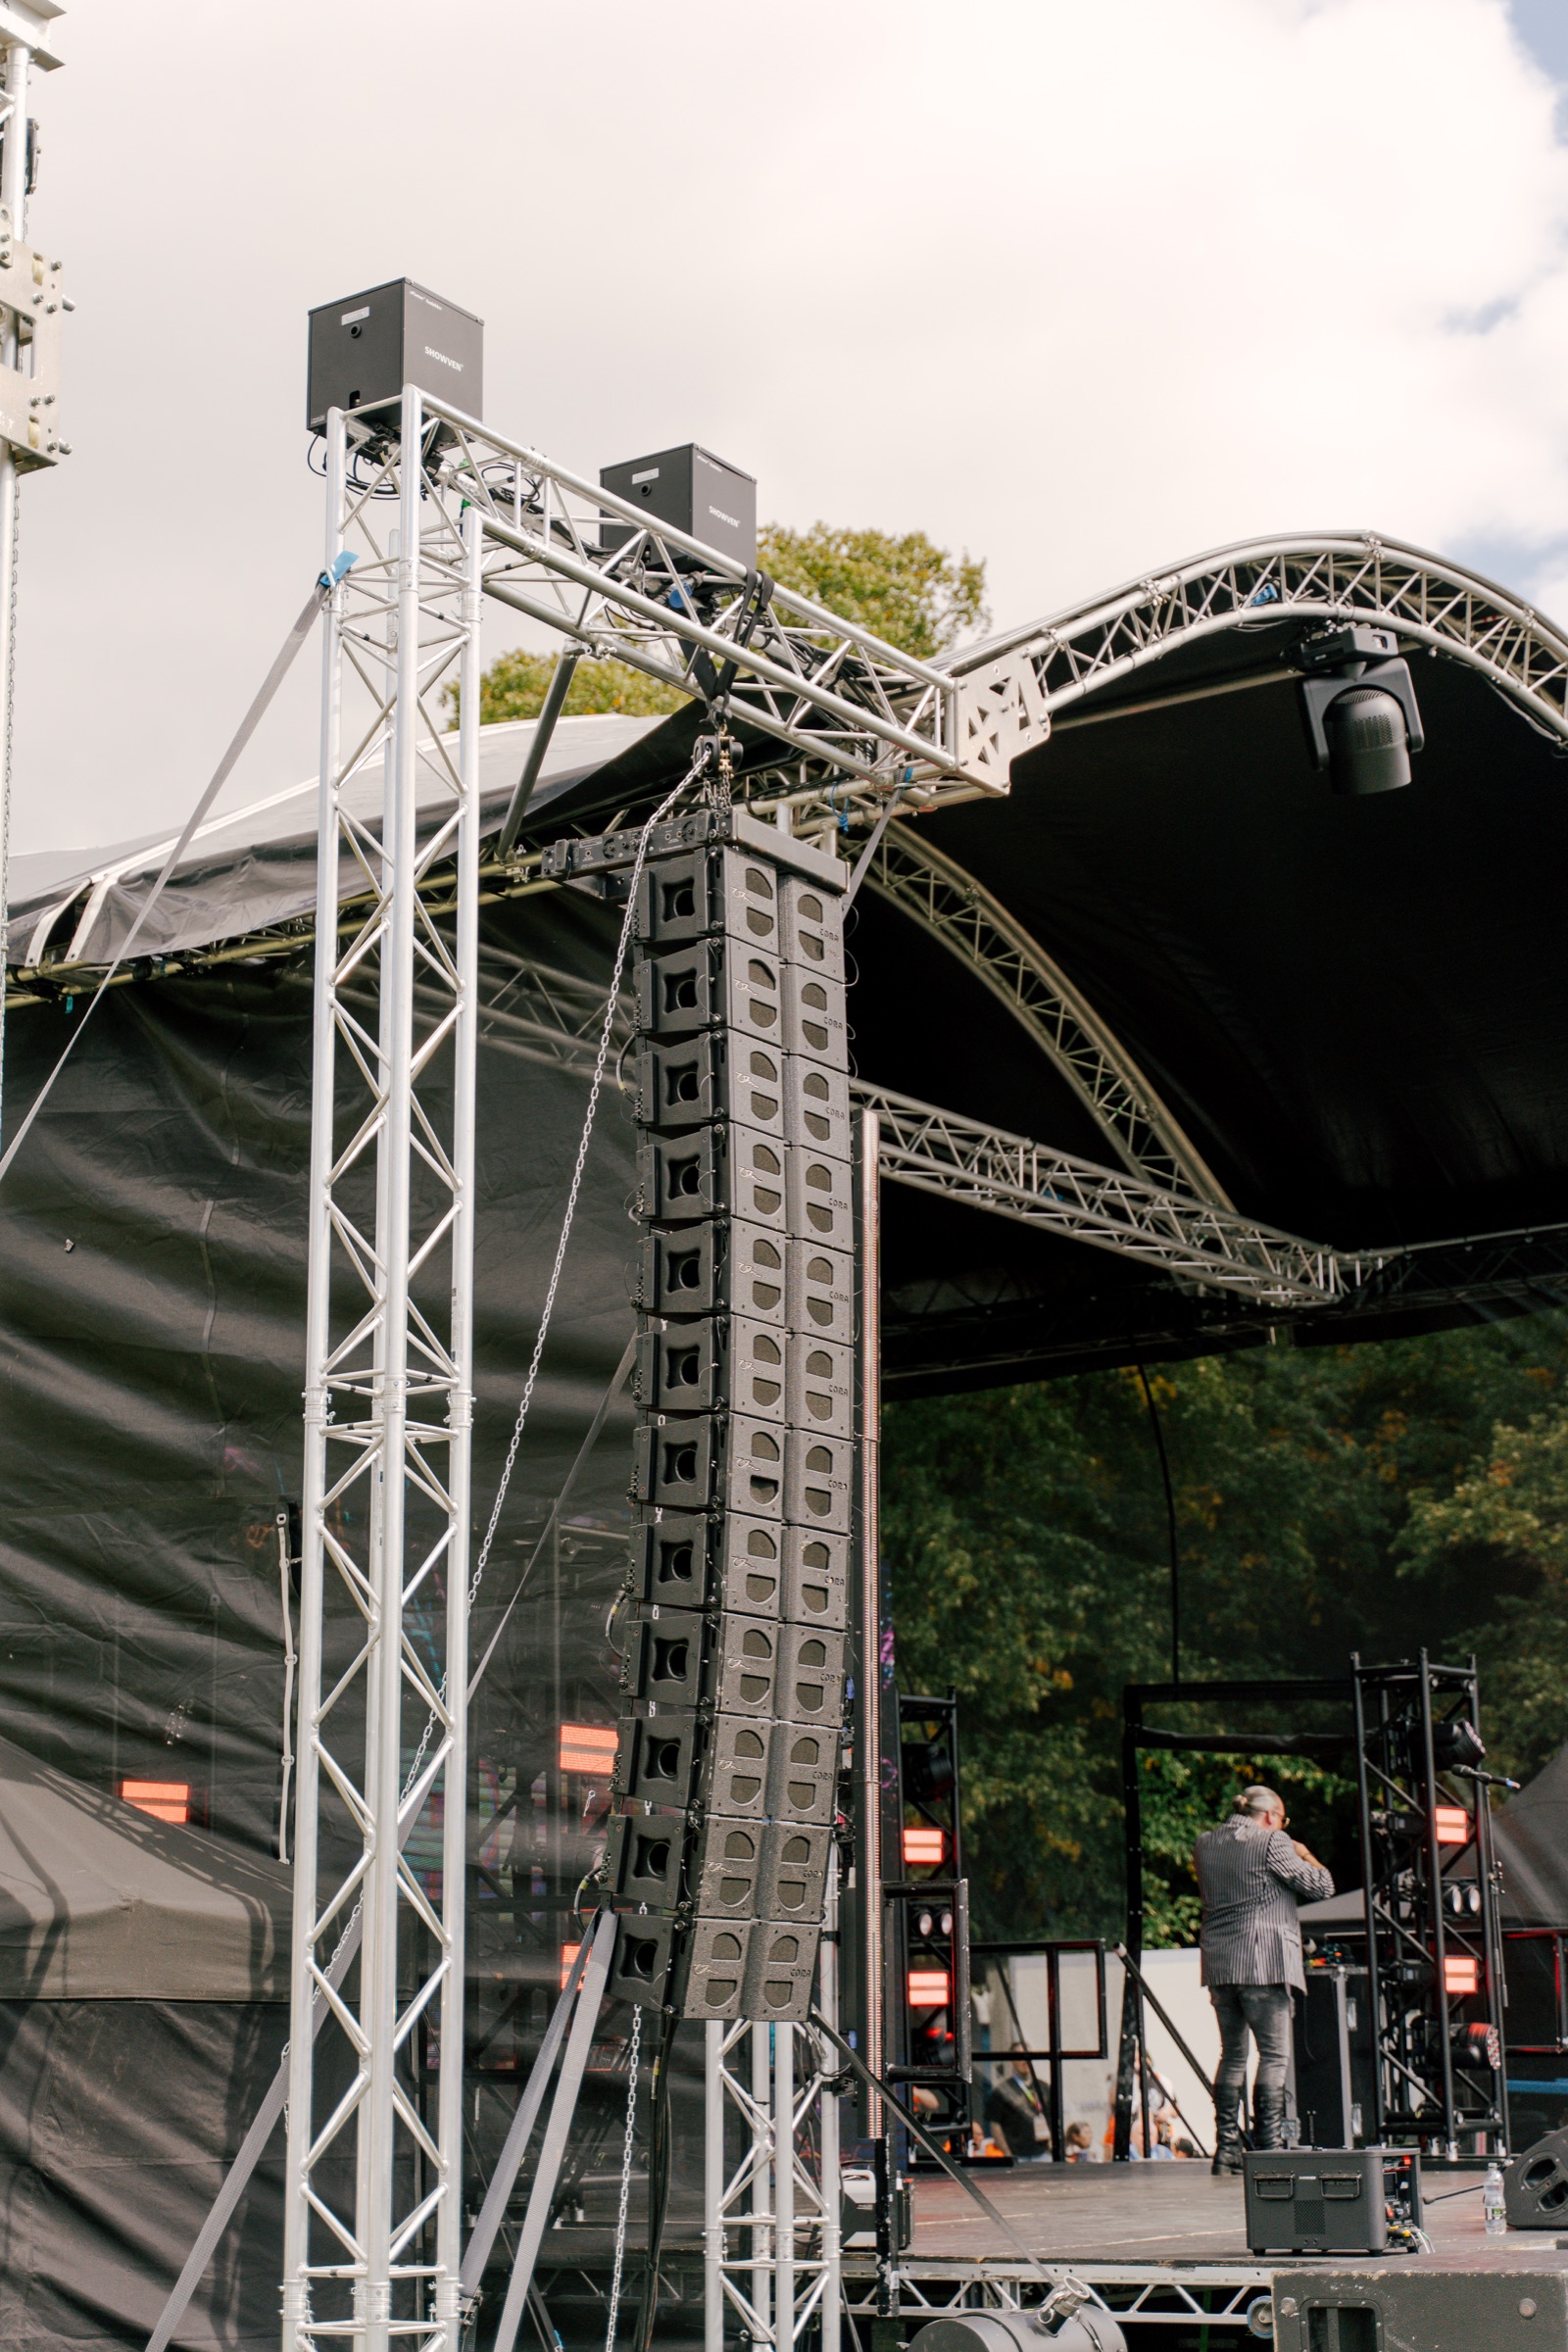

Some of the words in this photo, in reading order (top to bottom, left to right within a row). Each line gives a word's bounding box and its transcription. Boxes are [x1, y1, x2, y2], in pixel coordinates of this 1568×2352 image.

[823, 1016, 843, 1030] CORA
[828, 1198, 849, 1210] CORA
[829, 1291, 850, 1303] CORA
[827, 1480, 848, 1491] CORA
